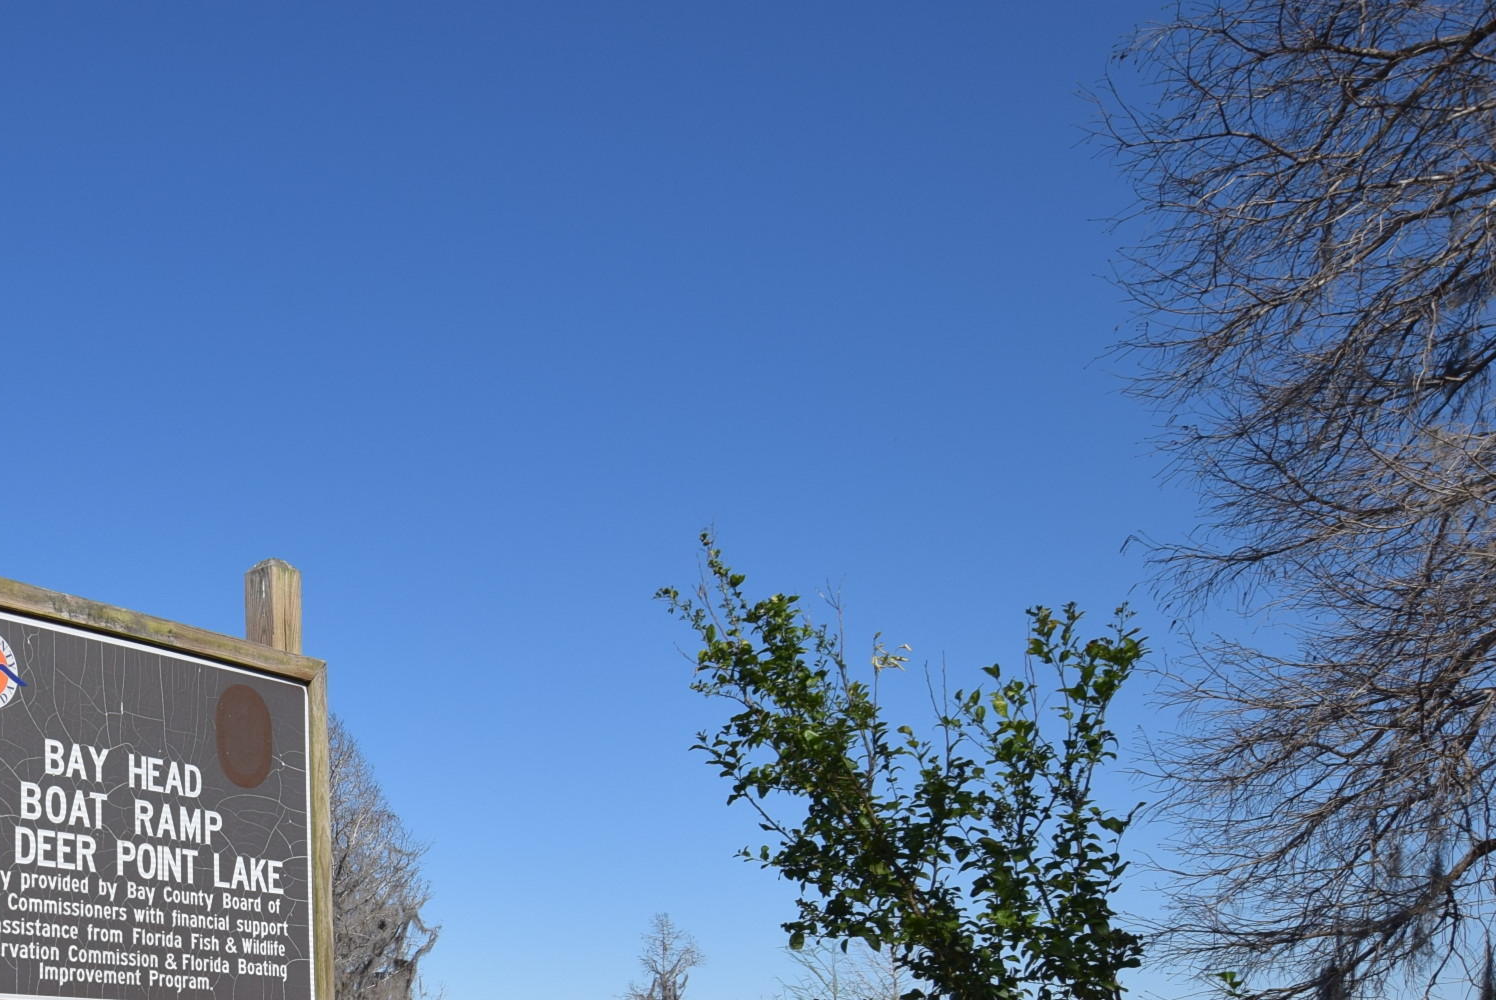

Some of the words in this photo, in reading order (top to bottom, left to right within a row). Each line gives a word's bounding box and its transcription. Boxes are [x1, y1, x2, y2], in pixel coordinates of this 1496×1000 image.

[45, 738, 110, 782] BAY
[128, 753, 202, 798] HEAD
[21, 781, 108, 829] BOAT
[135, 798, 223, 845] RAMP
[15, 826, 97, 872] DEER
[117, 840, 199, 884] POINT
[214, 853, 284, 894] LAKE
[21, 872, 89, 893] provided
[98, 878, 117, 901] by
[127, 881, 155, 905] Bay
[163, 886, 213, 911] County
[222, 893, 261, 912] Board
[268, 899, 280, 914] of
[7, 893, 127, 921] Commissioners
[133, 908, 164, 924] with
[172, 911, 229, 930] financial
[236, 919, 288, 938] support
[87, 924, 123, 943] from
[132, 928, 182, 948] Florida
[191, 933, 219, 951] Fish
[225, 937, 237, 953] &
[242, 938, 286, 956] Wildlife
[39, 962, 141, 986] Improvement
[149, 970, 213, 992] Program.
[68, 945, 159, 968] Commission
[164, 953, 177, 970] &
[182, 954, 229, 973] Florida
[238, 958, 288, 982] Boating
